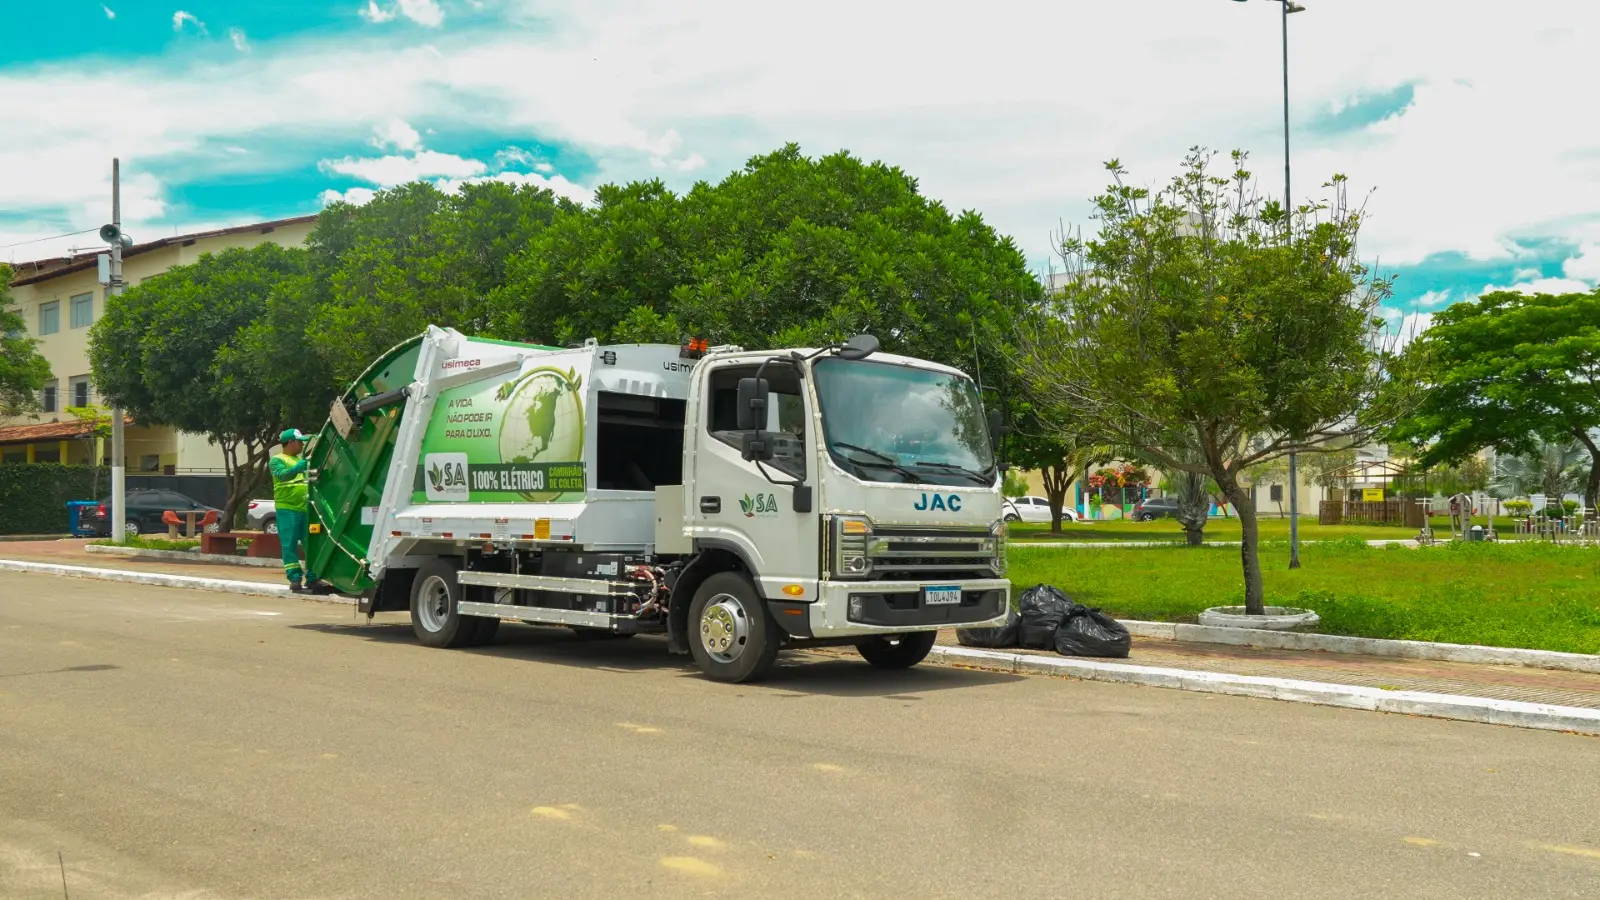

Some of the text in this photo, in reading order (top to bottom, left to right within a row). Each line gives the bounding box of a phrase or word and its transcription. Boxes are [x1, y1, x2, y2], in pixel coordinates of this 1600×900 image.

[441, 359, 481, 369] usimeca
[448, 398, 473, 408] A VIDA
[447, 411, 493, 423] NÃO PODE IR
[445, 428, 492, 439] PARA O LIXO.
[444, 462, 467, 486] SA
[548, 464, 582, 477] CAMINHÃO
[472, 466, 544, 490] 100% ELÉTRICO
[549, 478, 583, 489] DE COLETA
[756, 493, 778, 513] SA
[914, 492, 962, 512] JAC
